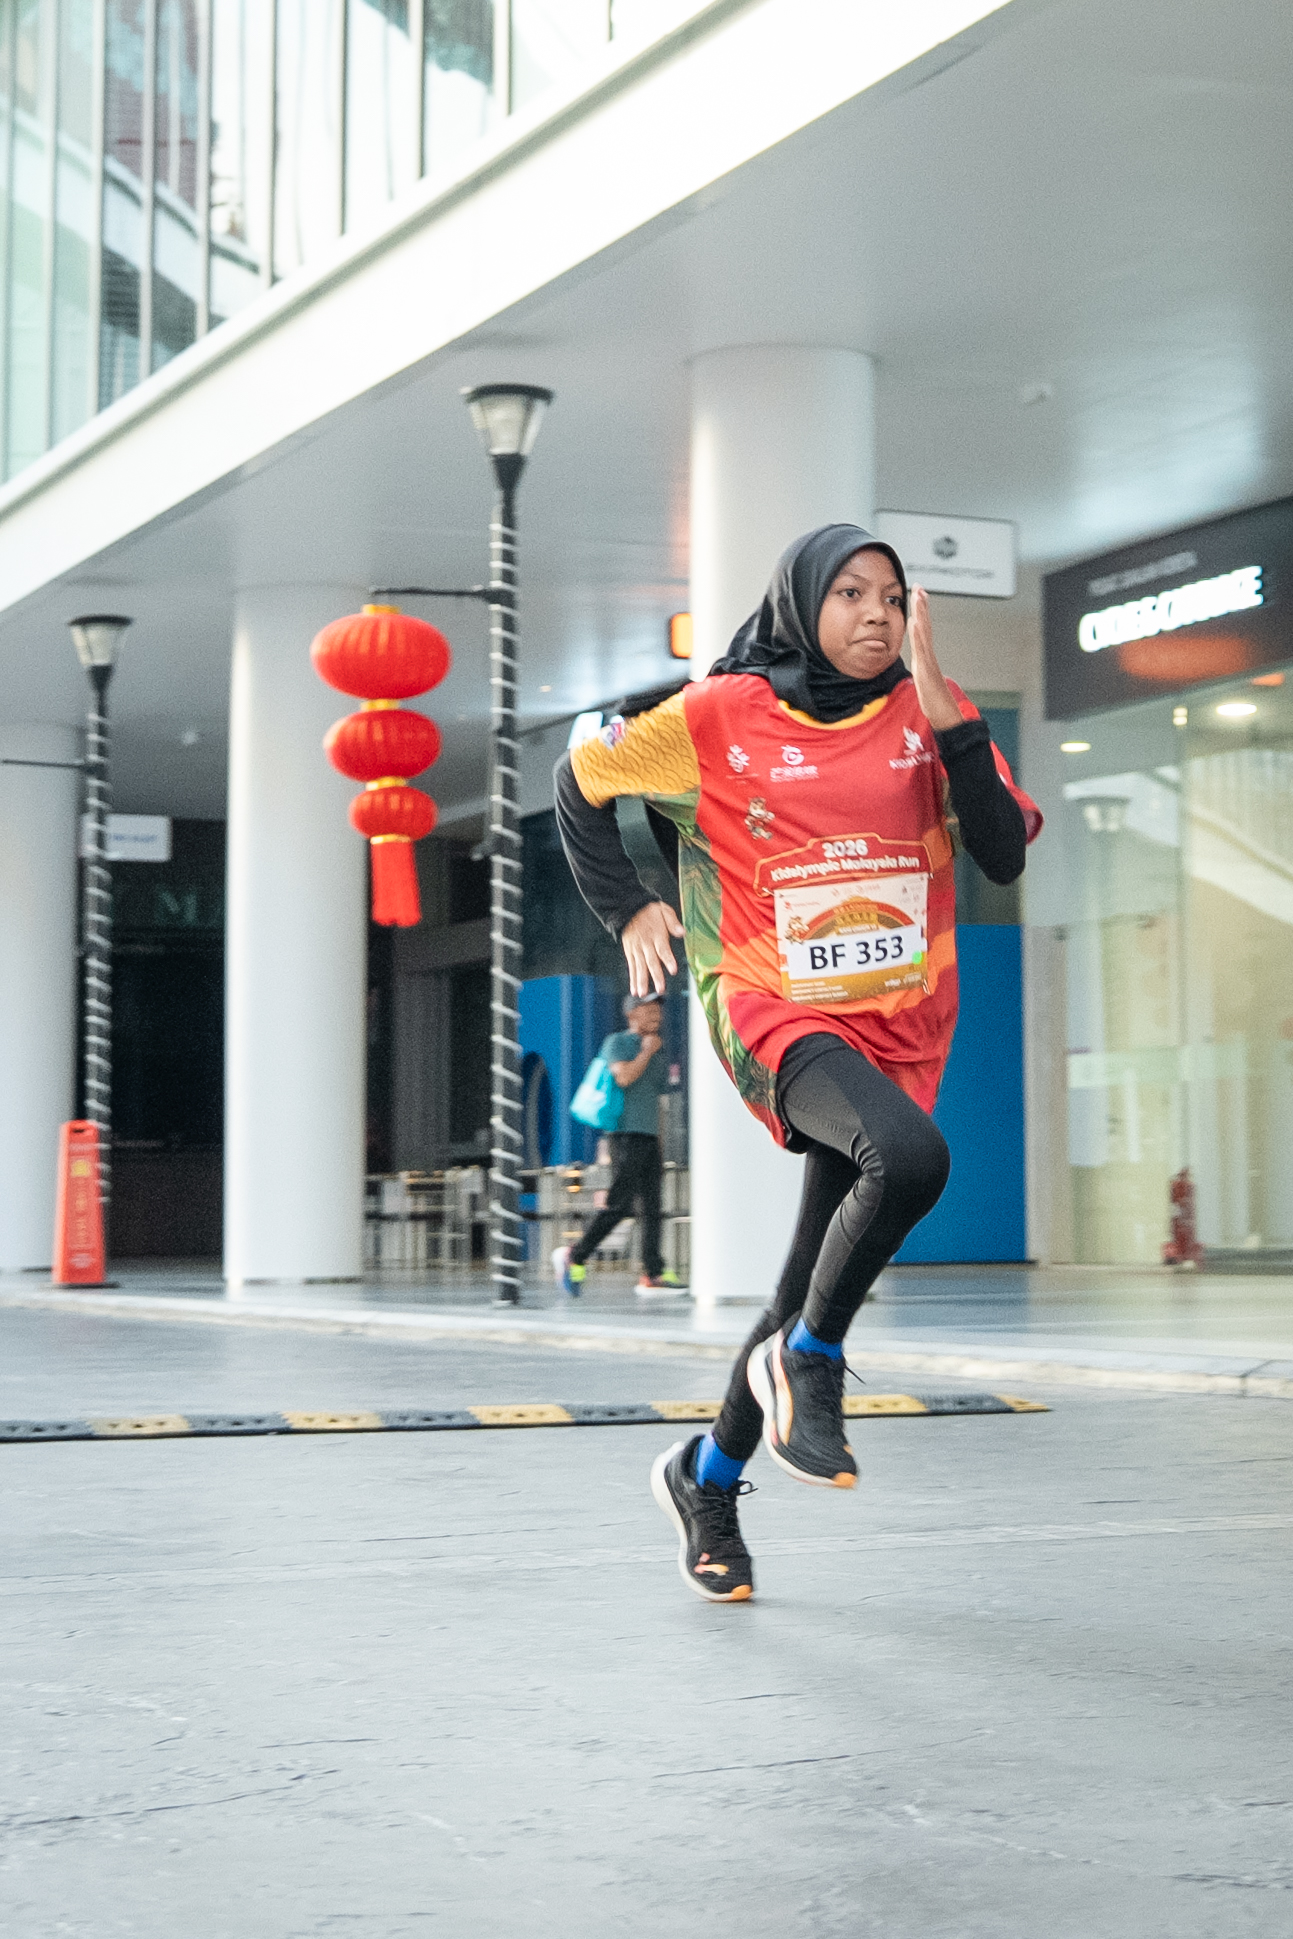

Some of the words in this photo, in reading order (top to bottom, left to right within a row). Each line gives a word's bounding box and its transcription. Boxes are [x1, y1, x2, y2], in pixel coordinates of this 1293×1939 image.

[822, 839, 868, 858] 2026
[840, 855, 898, 872] Malaysia
[897, 855, 920, 868] Run
[809, 943, 846, 970] BF
[855, 935, 904, 965] 353
